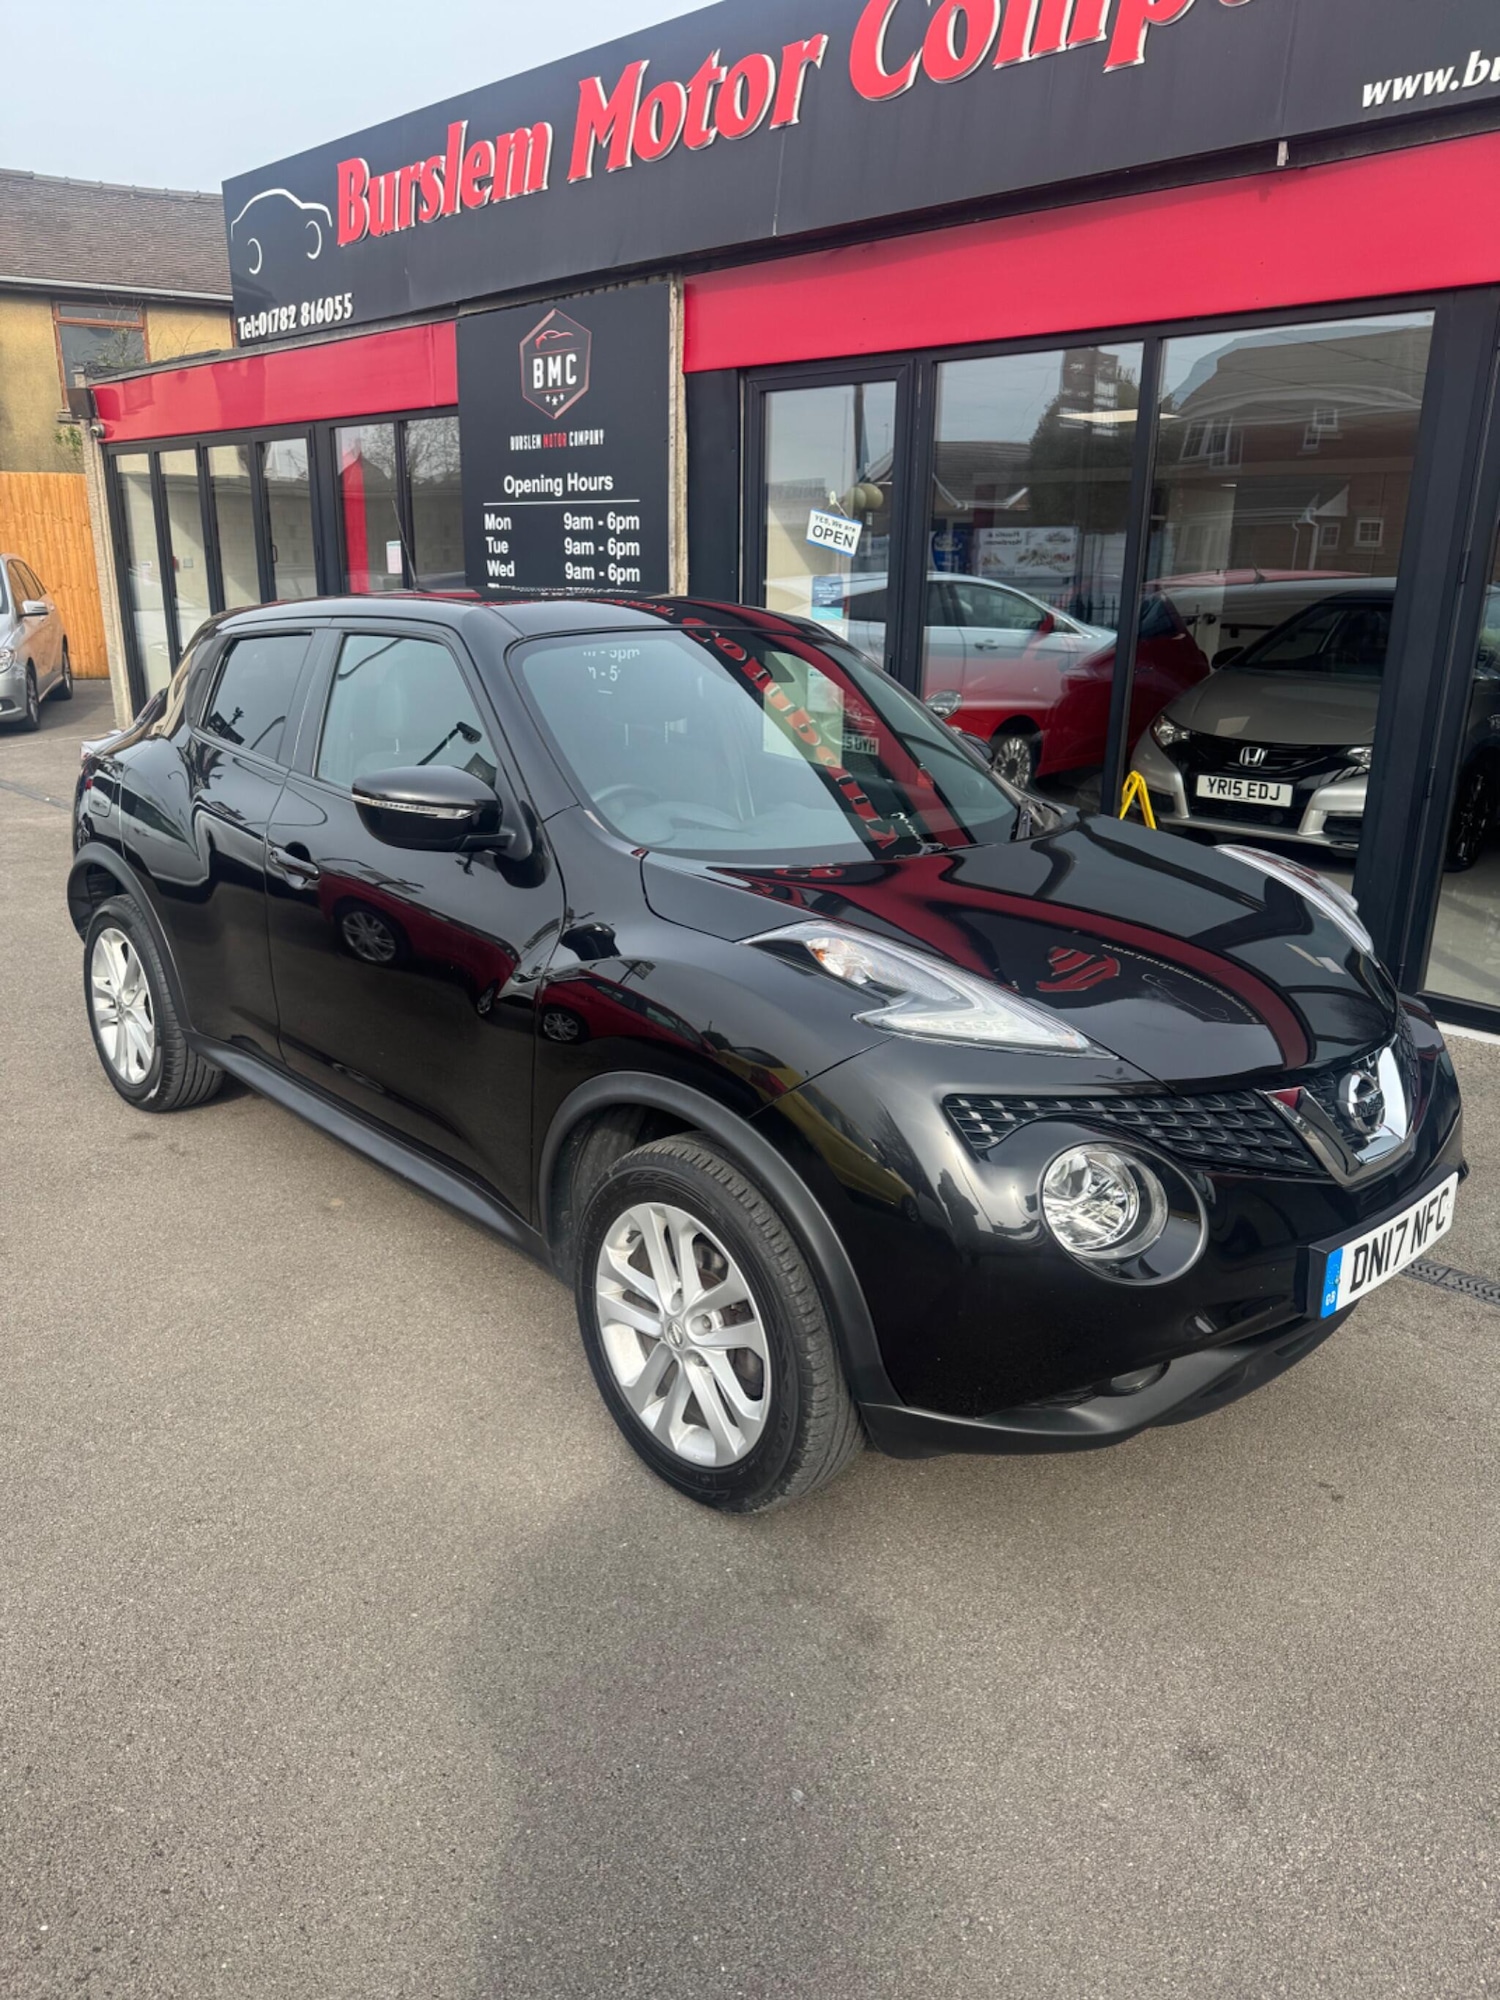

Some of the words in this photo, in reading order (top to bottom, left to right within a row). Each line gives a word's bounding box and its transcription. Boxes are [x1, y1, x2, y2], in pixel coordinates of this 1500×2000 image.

[337, 120, 552, 247] Burslem
[569, 33, 829, 183] Motor
[849, 0, 1256, 101] Comp
[238, 305, 296, 340] Tel:01782
[301, 293, 353, 327] 816055
[533, 353, 577, 389] BMC
[543, 432, 567, 448] MOTOR
[569, 429, 604, 447] COMPANY
[504, 474, 563, 497] Opening
[567, 472, 613, 492] Hours
[484, 513, 512, 531] Mon
[564, 512, 593, 530] 9am
[607, 512, 640, 534] 6pm
[486, 536, 509, 554] Tue
[564, 537, 594, 555] 9am
[607, 538, 640, 559] 6pm
[812, 525, 854, 548] OPEN
[487, 560, 515, 578] Wed
[565, 563, 594, 581] 9am
[608, 563, 640, 585] 6pm
[1208, 778, 1243, 796] YR15
[1247, 782, 1280, 800] EDJ
[1350, 1218, 1409, 1293] DN17
[1410, 1190, 1450, 1249] NFC
